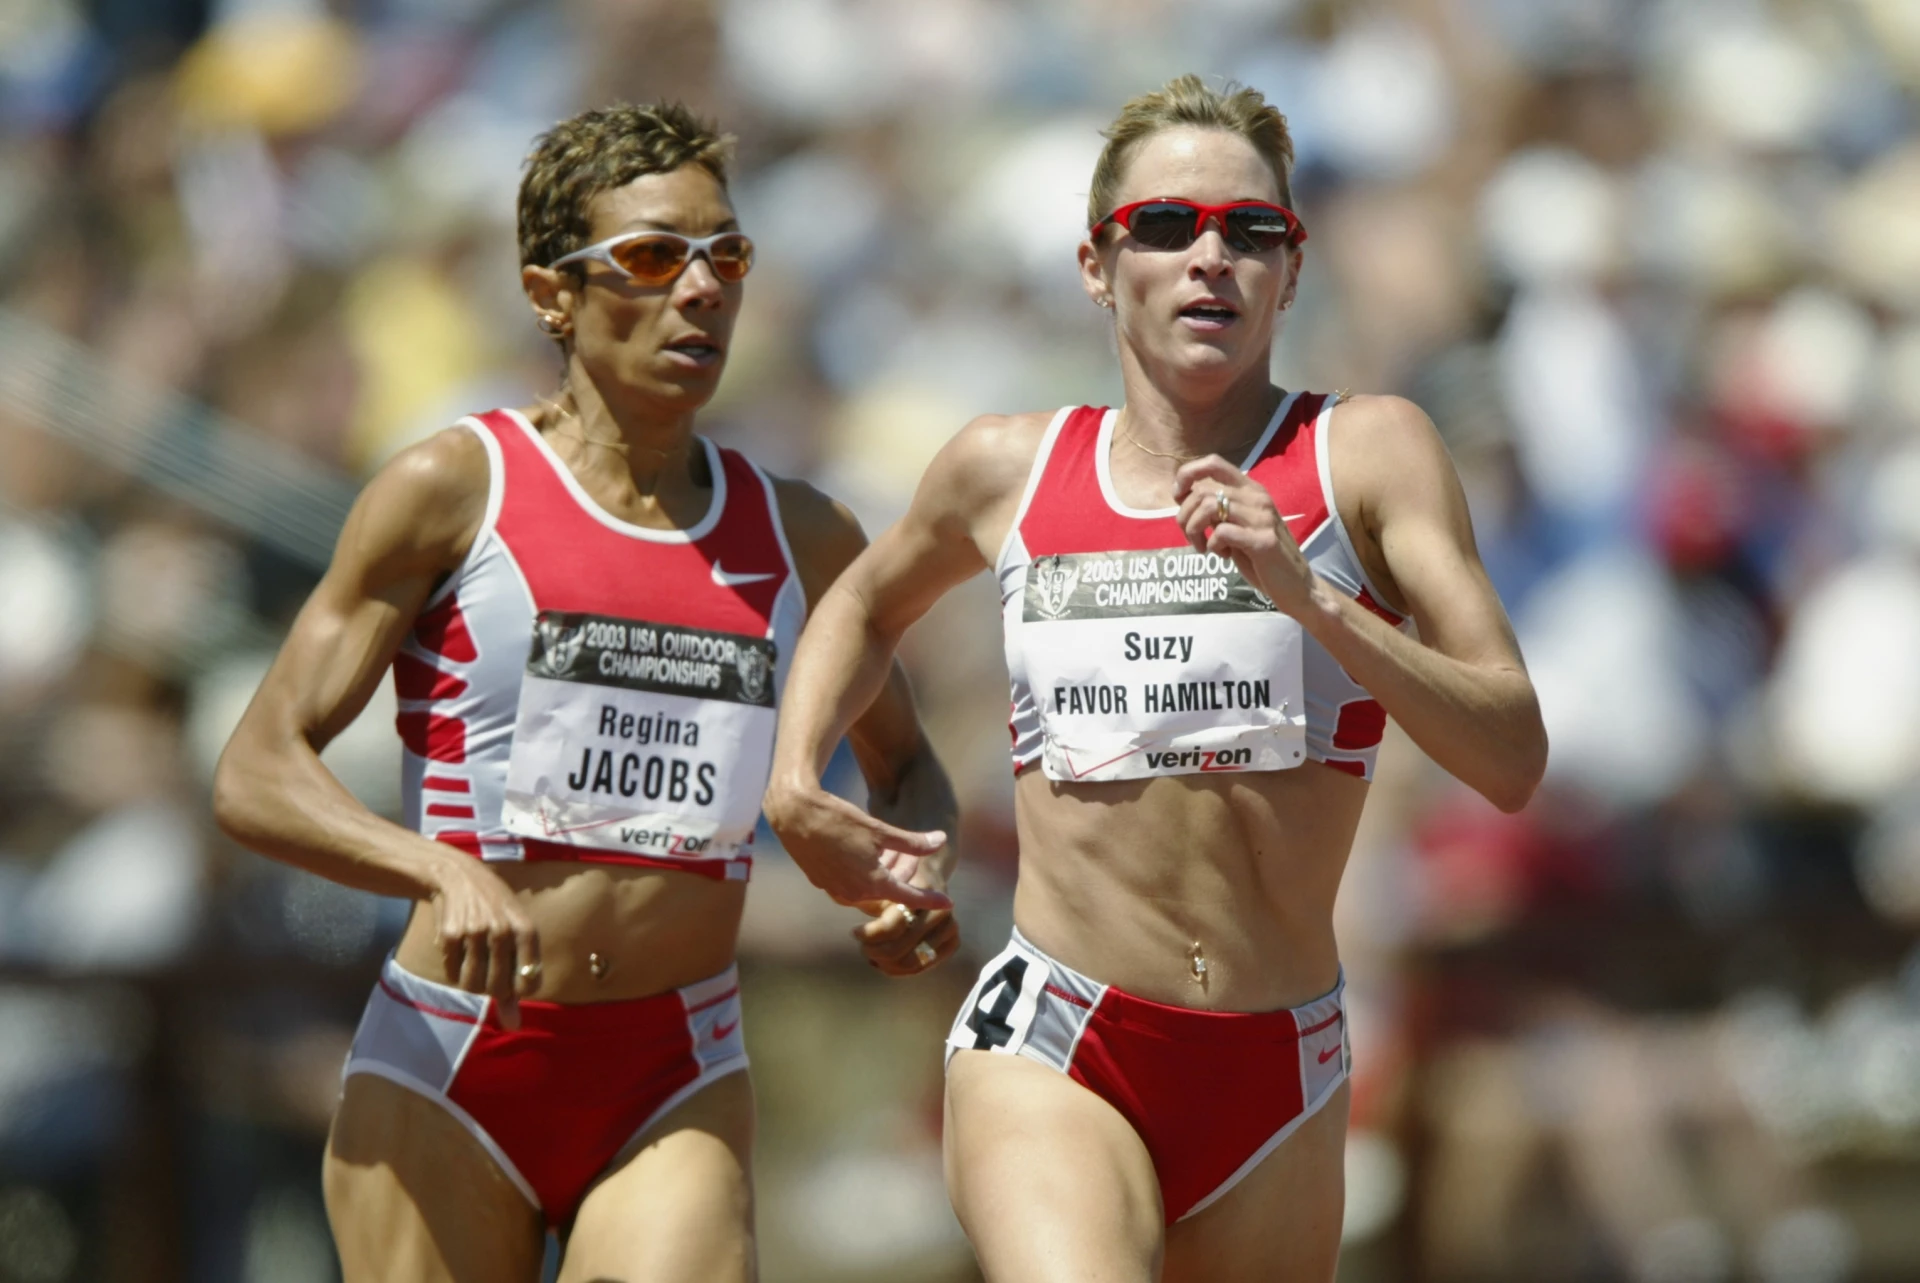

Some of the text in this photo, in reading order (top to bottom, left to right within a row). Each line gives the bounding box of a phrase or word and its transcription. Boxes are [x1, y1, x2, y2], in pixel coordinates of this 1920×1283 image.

[1081, 552, 1239, 583] 2003 USA OUTDOO
[1095, 577, 1228, 606] CHAMPIONSHIPS
[586, 621, 737, 663] 2003 USA OUTDOOR
[1124, 631, 1194, 663] Suzy
[599, 651, 722, 690] CHAMPIONSHIPS
[1054, 679, 1271, 715] FAVOR HAMILTON
[598, 704, 700, 747] Regina
[1146, 746, 1252, 771] verizon
[567, 748, 717, 807] JACOBS
[965, 954, 1030, 1050] 4
